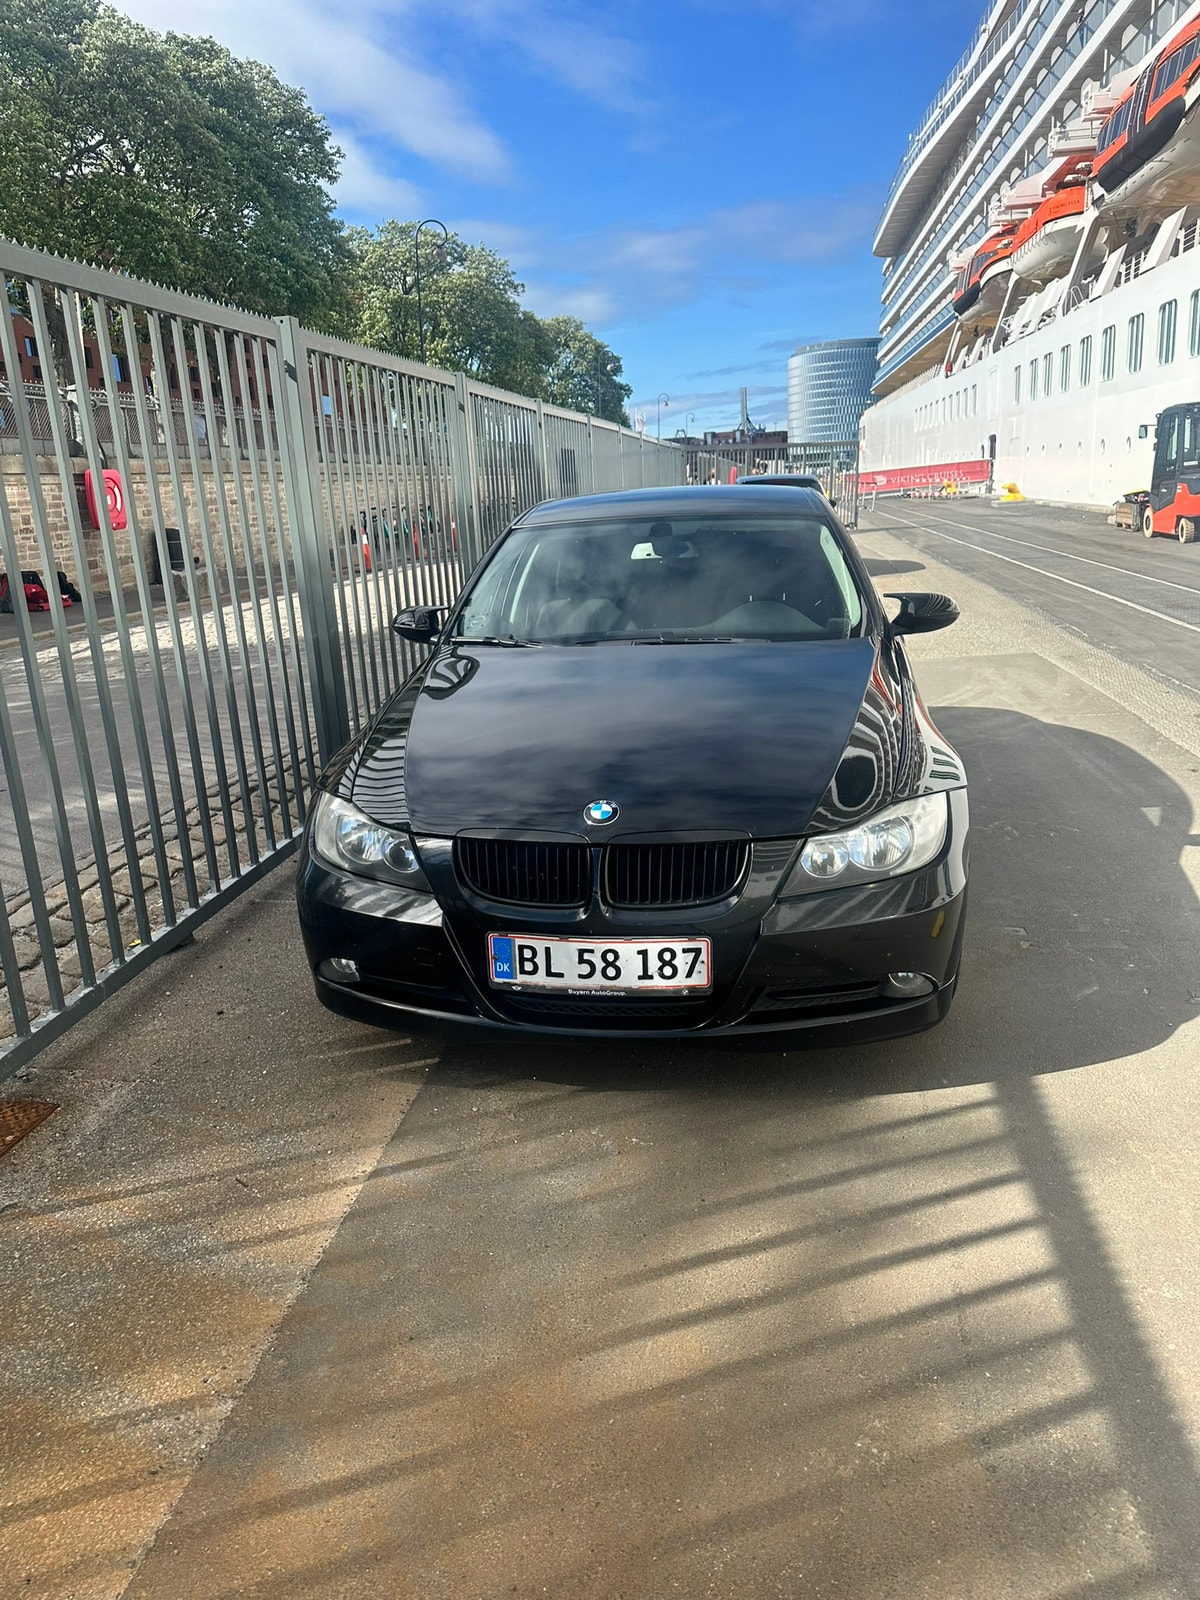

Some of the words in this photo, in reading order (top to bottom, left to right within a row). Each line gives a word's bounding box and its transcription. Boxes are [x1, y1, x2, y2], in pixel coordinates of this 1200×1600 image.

[890, 474, 924, 484] VIKING
[927, 469, 964, 481] CRUISES
[496, 962, 510, 972] DK
[517, 944, 564, 978] BL
[577, 948, 622, 981] 58
[637, 947, 702, 981] 187
